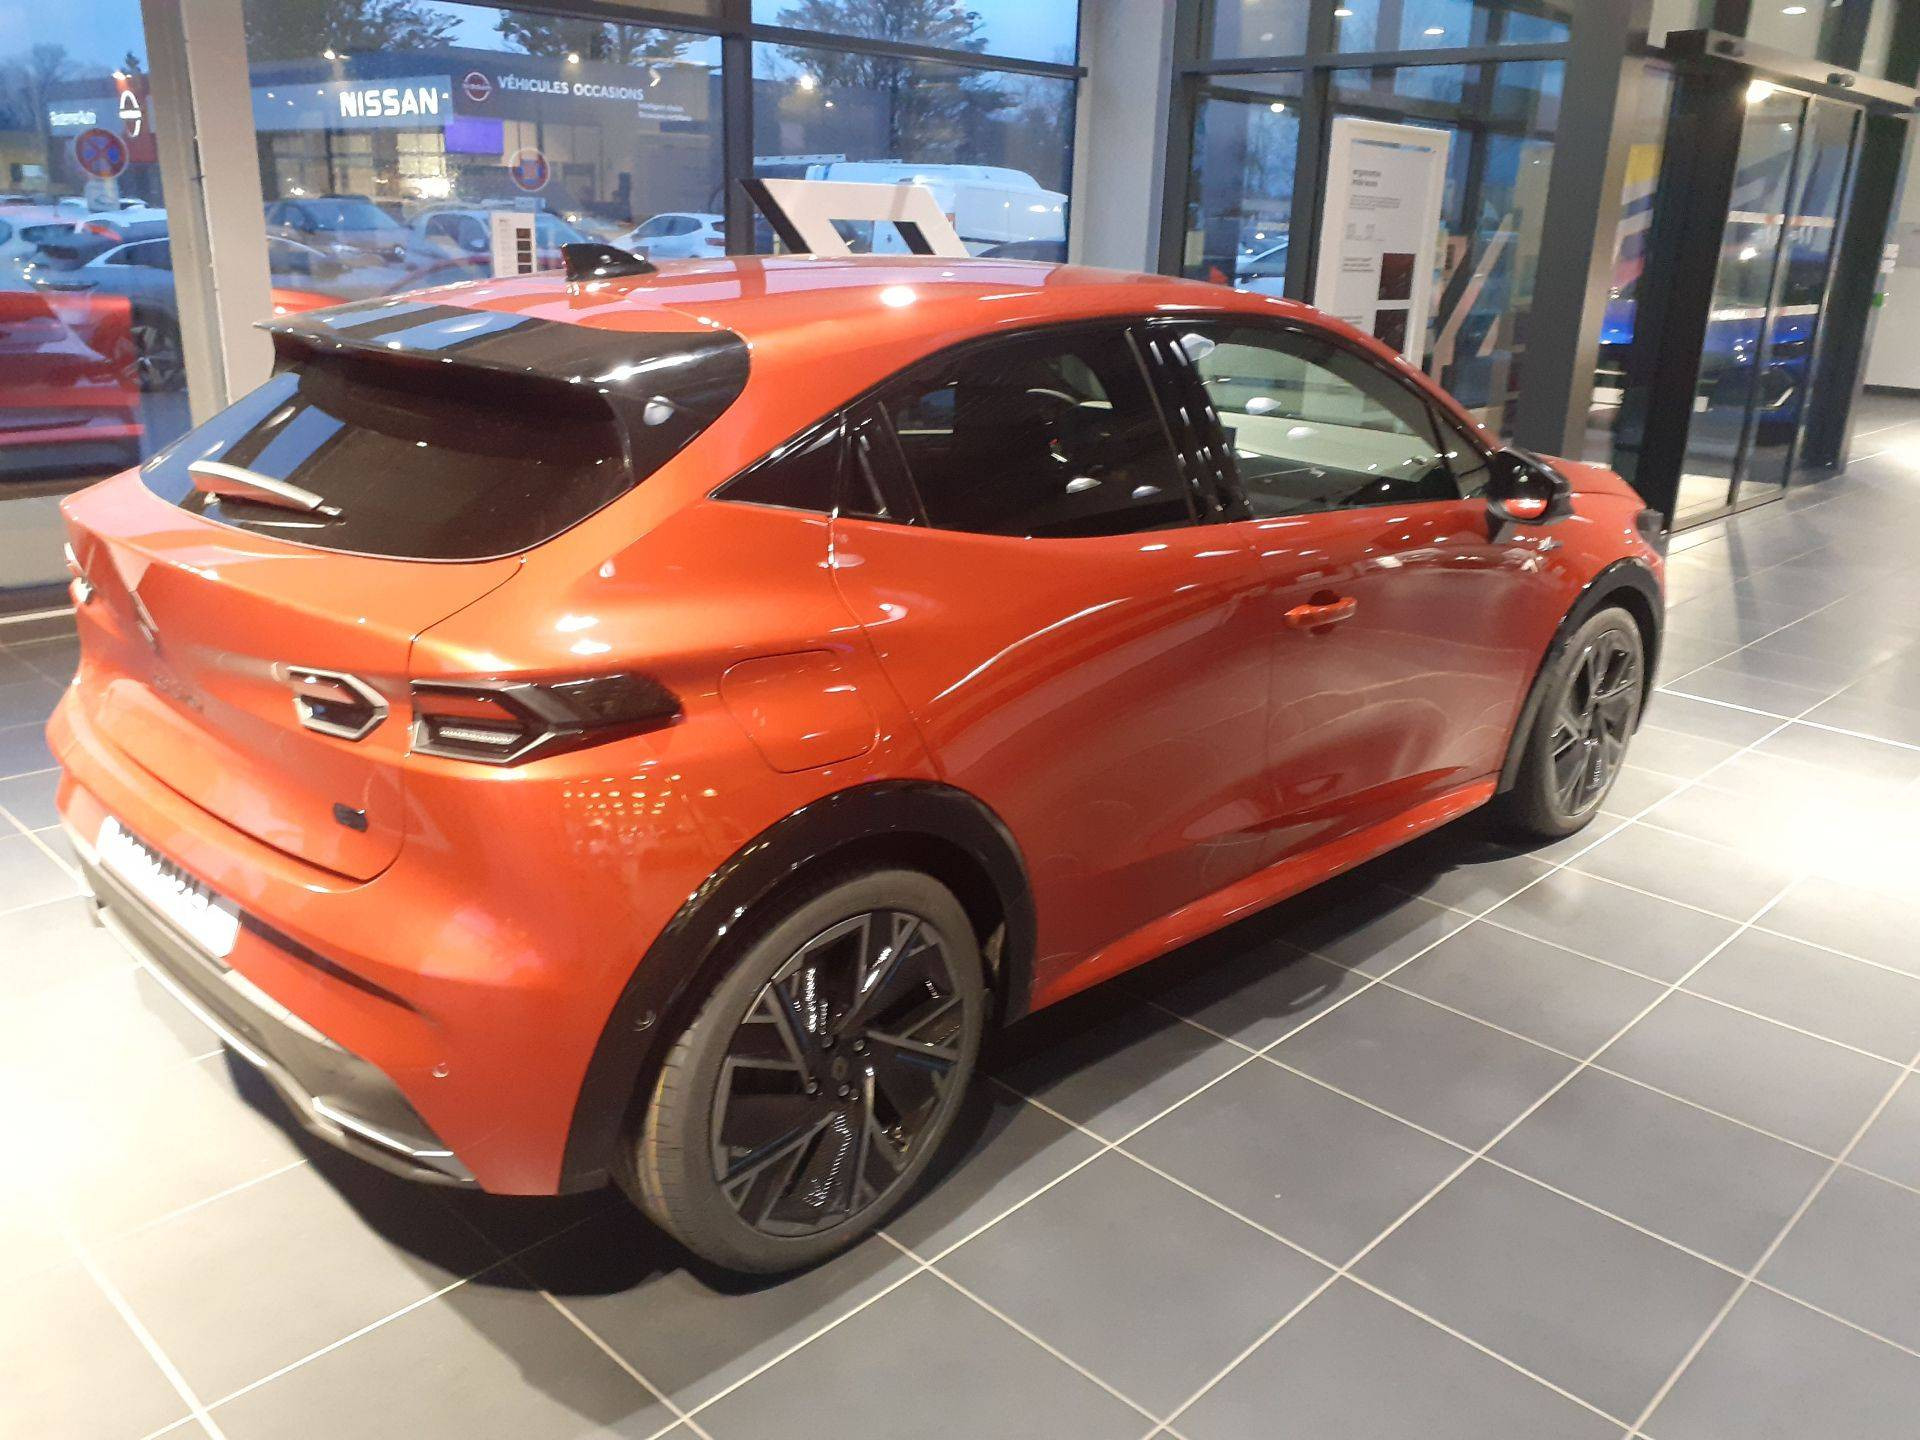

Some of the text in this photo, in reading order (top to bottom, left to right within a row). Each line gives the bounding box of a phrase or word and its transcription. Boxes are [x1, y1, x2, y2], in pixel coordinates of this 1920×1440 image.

[497, 74, 644, 101] VÉHICULES OCCASIONS
[339, 87, 438, 117] NISSAN
